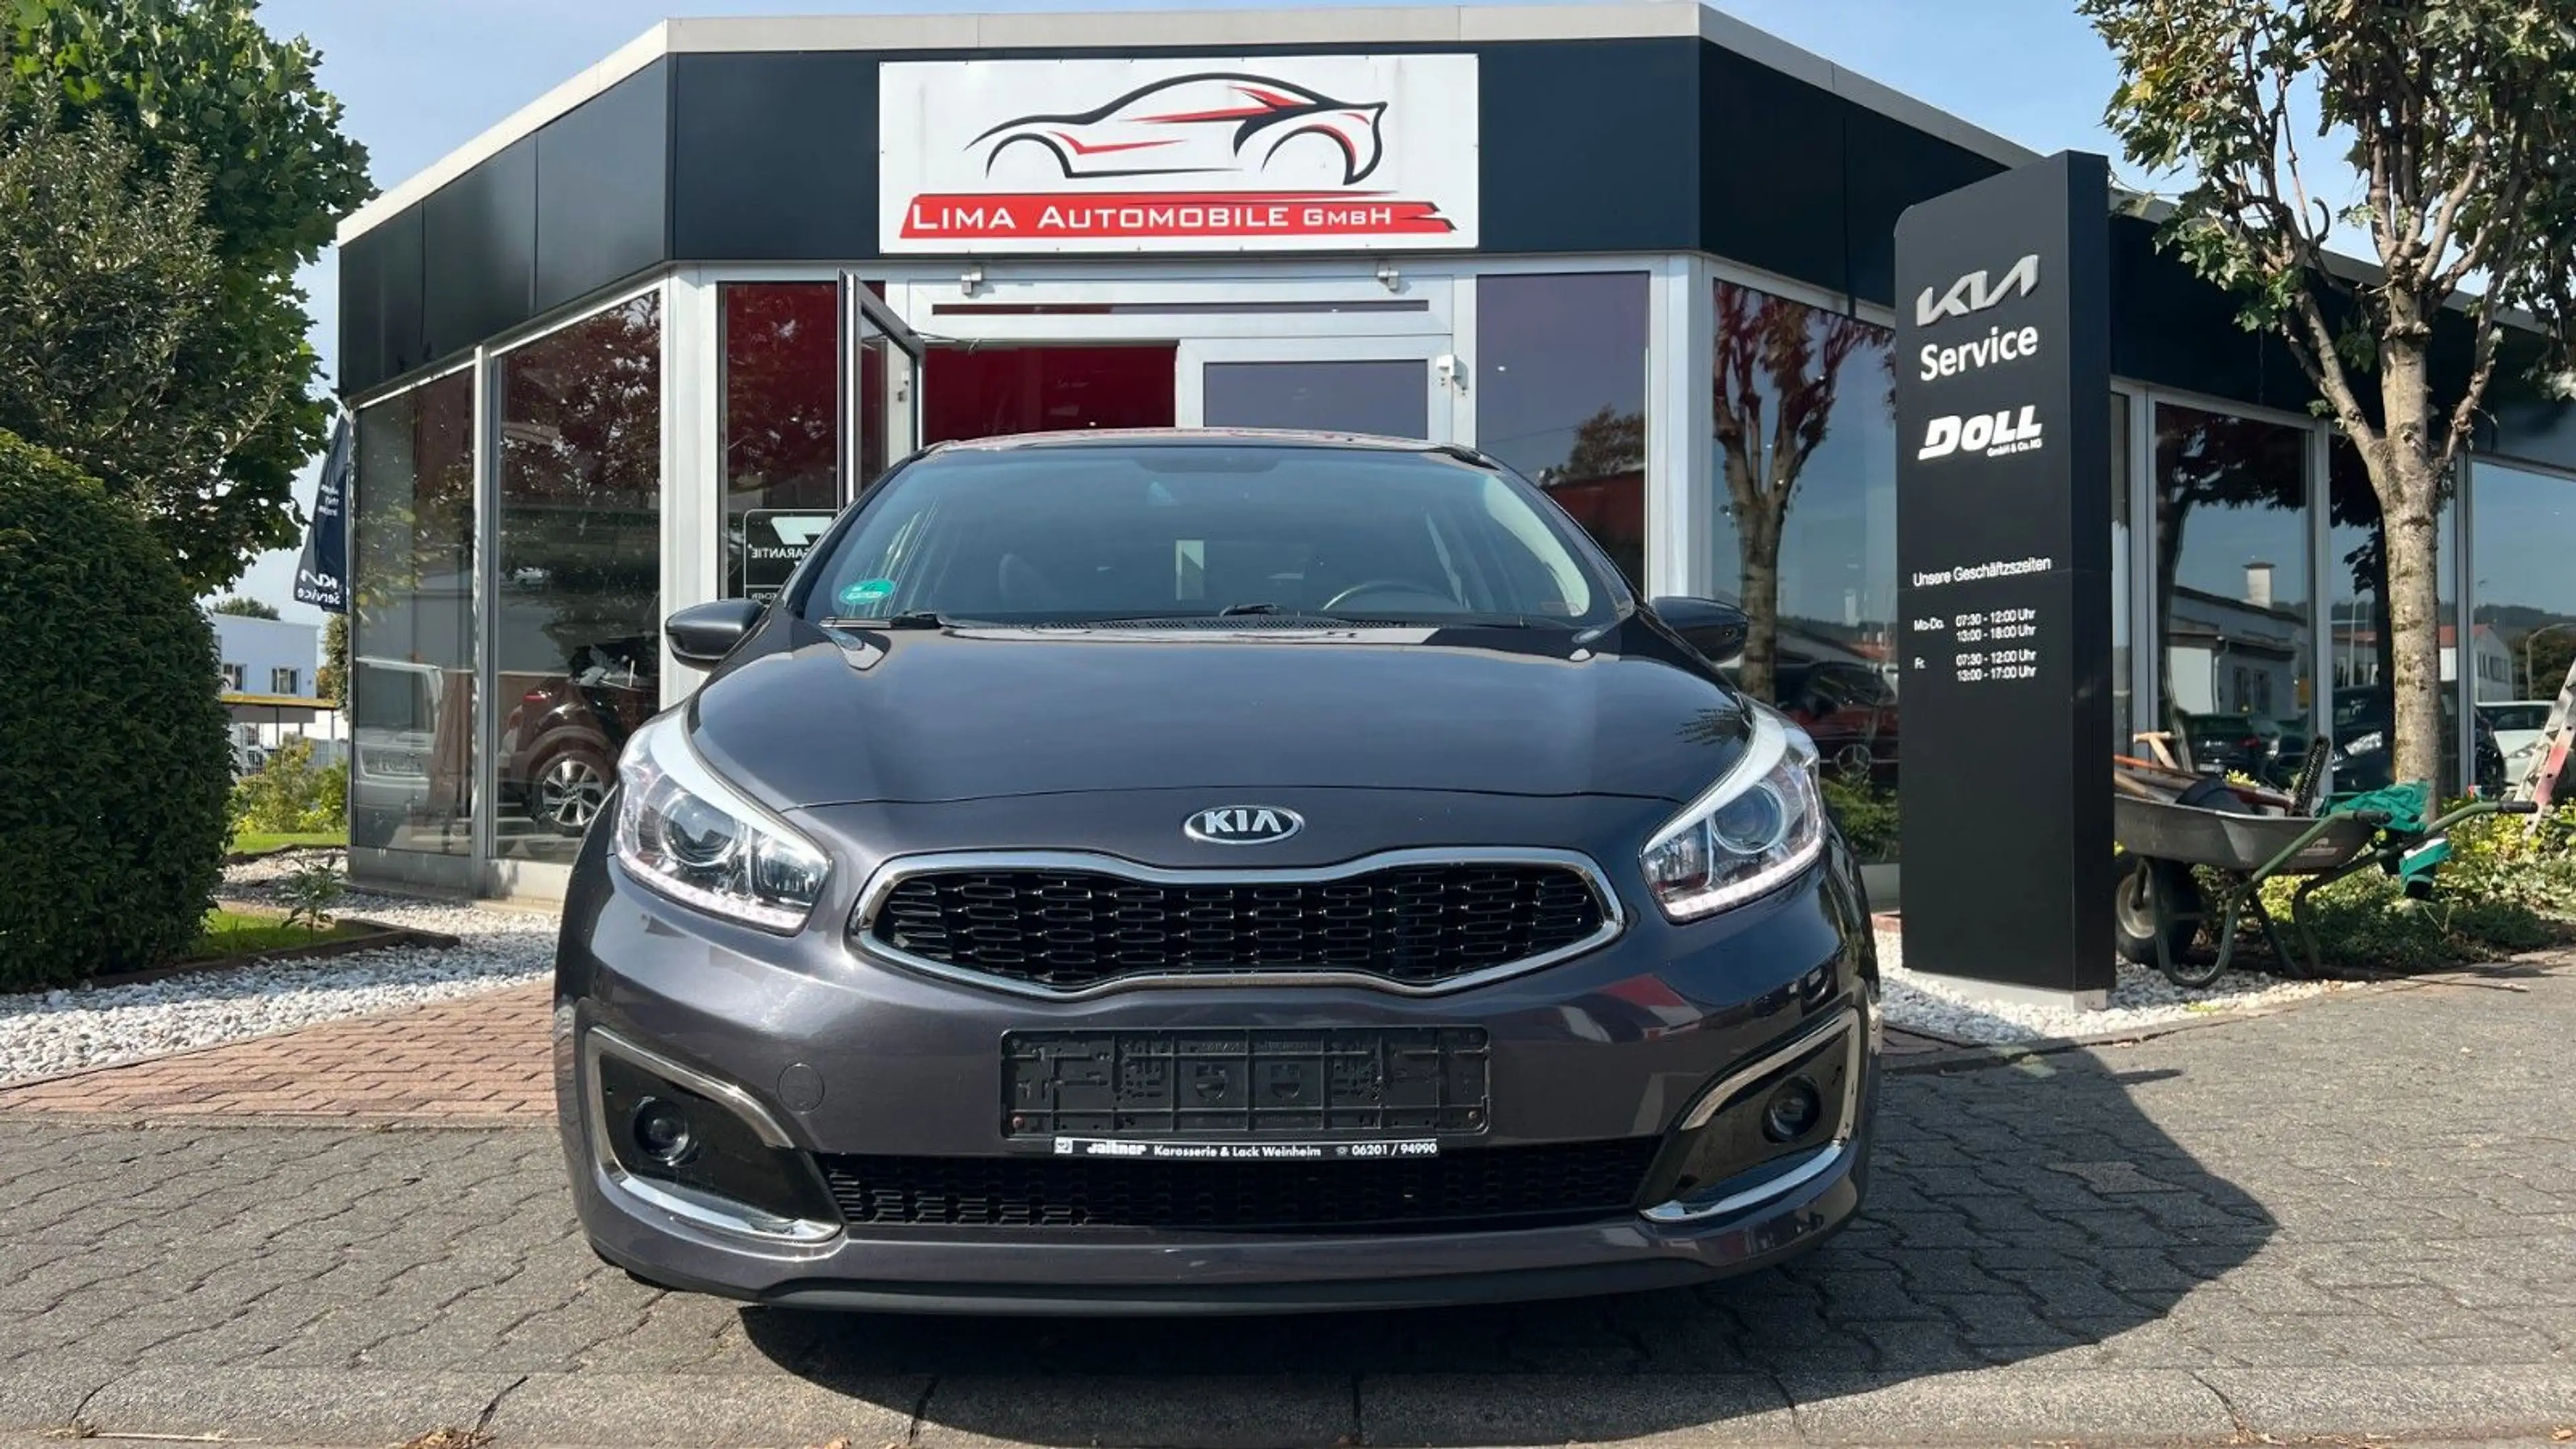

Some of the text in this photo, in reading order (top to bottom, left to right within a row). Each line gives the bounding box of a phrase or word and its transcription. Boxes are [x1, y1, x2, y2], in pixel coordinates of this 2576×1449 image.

[912, 204, 1016, 229] LIMA
[1038, 206, 1289, 229] AUTOMOBILE
[1917, 254, 2039, 326] KIA
[1921, 326, 2038, 381] Service
[1918, 405, 2042, 460] DOLL
[1913, 572, 1951, 587] Unsere
[1955, 613, 1982, 627] 07:30
[1990, 610, 2017, 624] 12:00
[2017, 608, 2035, 621] Uhr
[1956, 629, 1982, 642] 13:00
[1990, 625, 2017, 639] 18:00
[2018, 624, 2036, 637] Uhr
[1955, 653, 1982, 667] 07:30
[1990, 650, 2017, 664] 12:00
[2019, 649, 2037, 661] Uhr
[1957, 668, 1982, 682] 13:00
[1991, 665, 2017, 680] 17:00
[2019, 665, 2037, 678] Uhr
[1204, 809, 1283, 833] KIA
[1154, 1144, 1217, 1157] Karosserie
[1220, 1146, 1229, 1157] &
[1233, 1145, 1259, 1157] Lack
[1262, 1145, 1322, 1157] Weinheim
[1352, 1144, 1387, 1155] 06201
[1401, 1142, 1437, 1154] 94990
